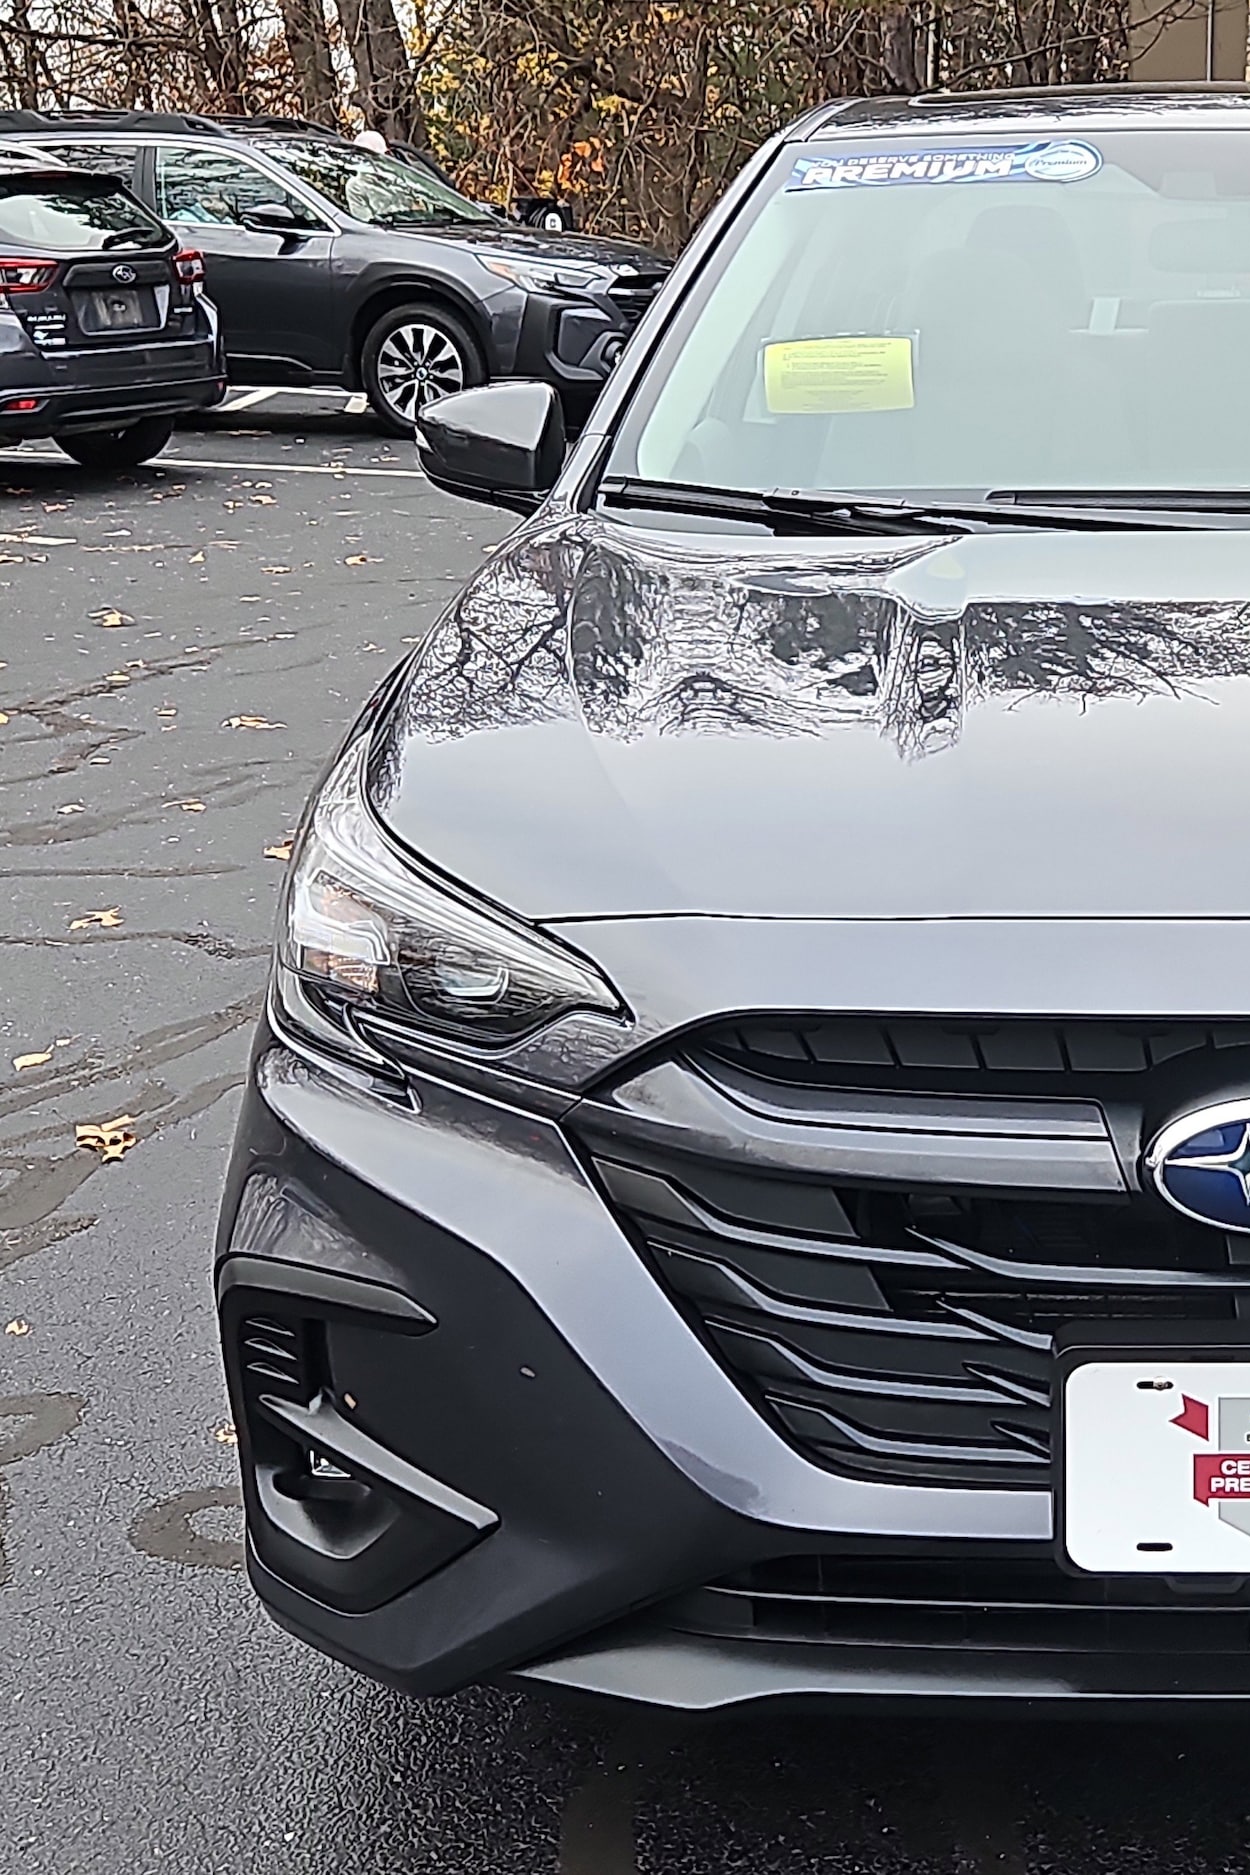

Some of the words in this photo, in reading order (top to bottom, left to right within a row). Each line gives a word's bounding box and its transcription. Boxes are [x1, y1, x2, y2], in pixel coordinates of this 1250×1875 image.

[847, 154, 920, 165] DESERVE
[922, 151, 1016, 163] SOMETHING
[801, 159, 1014, 185] PREMIUM
